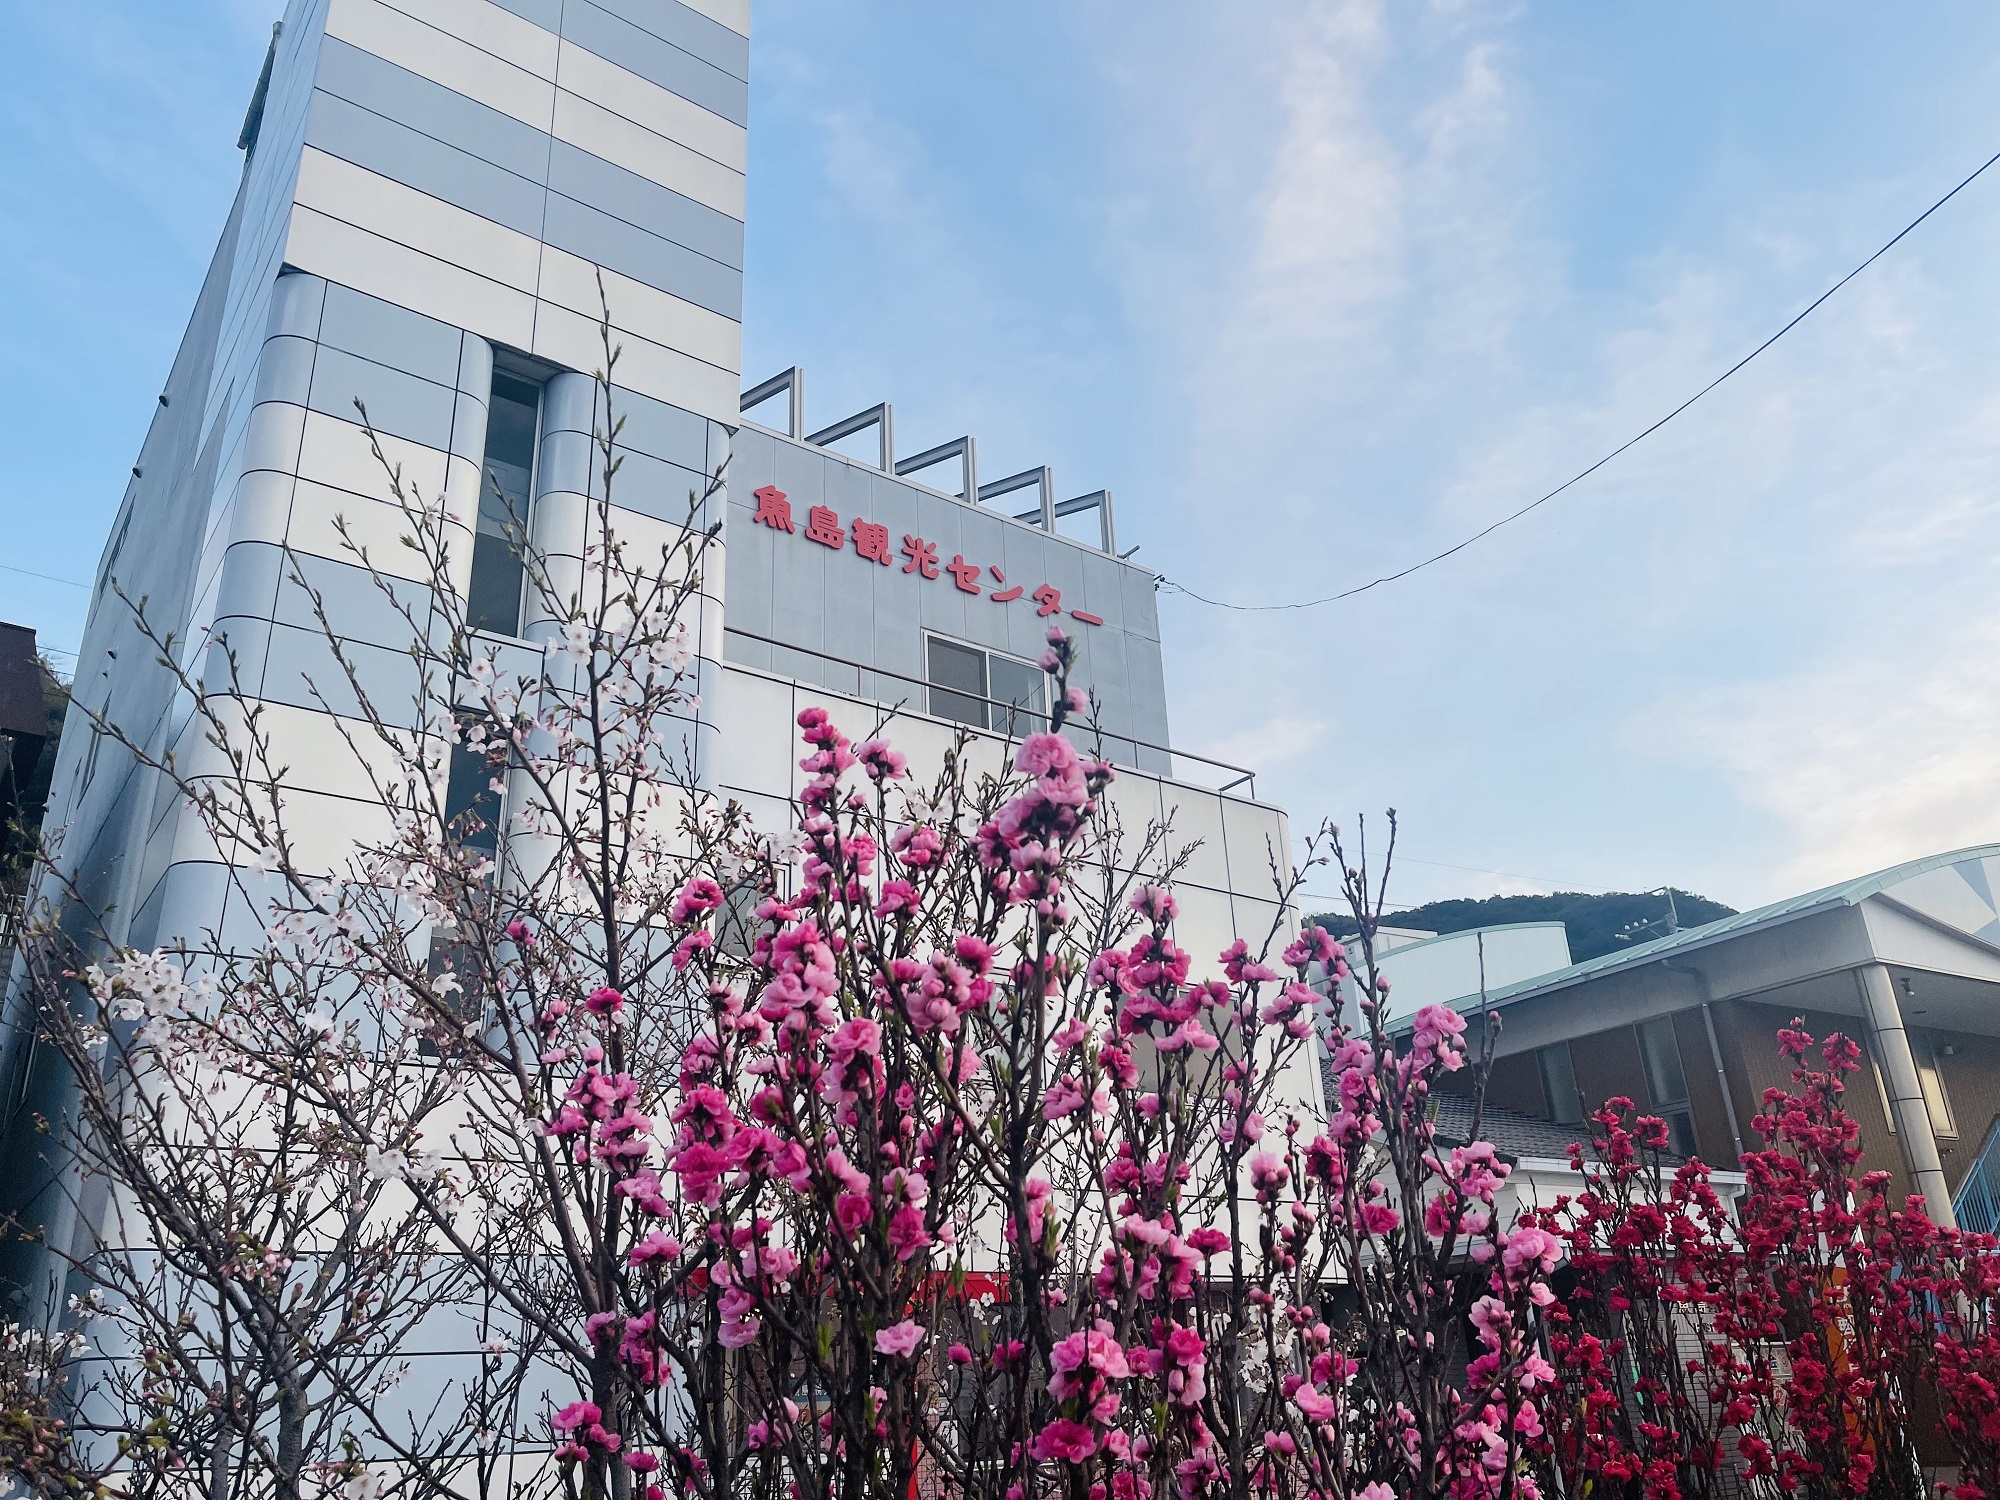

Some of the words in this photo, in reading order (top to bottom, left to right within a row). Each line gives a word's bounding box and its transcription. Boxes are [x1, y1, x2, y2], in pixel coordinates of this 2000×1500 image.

[753, 485, 1104, 626] 魚島観光センター
